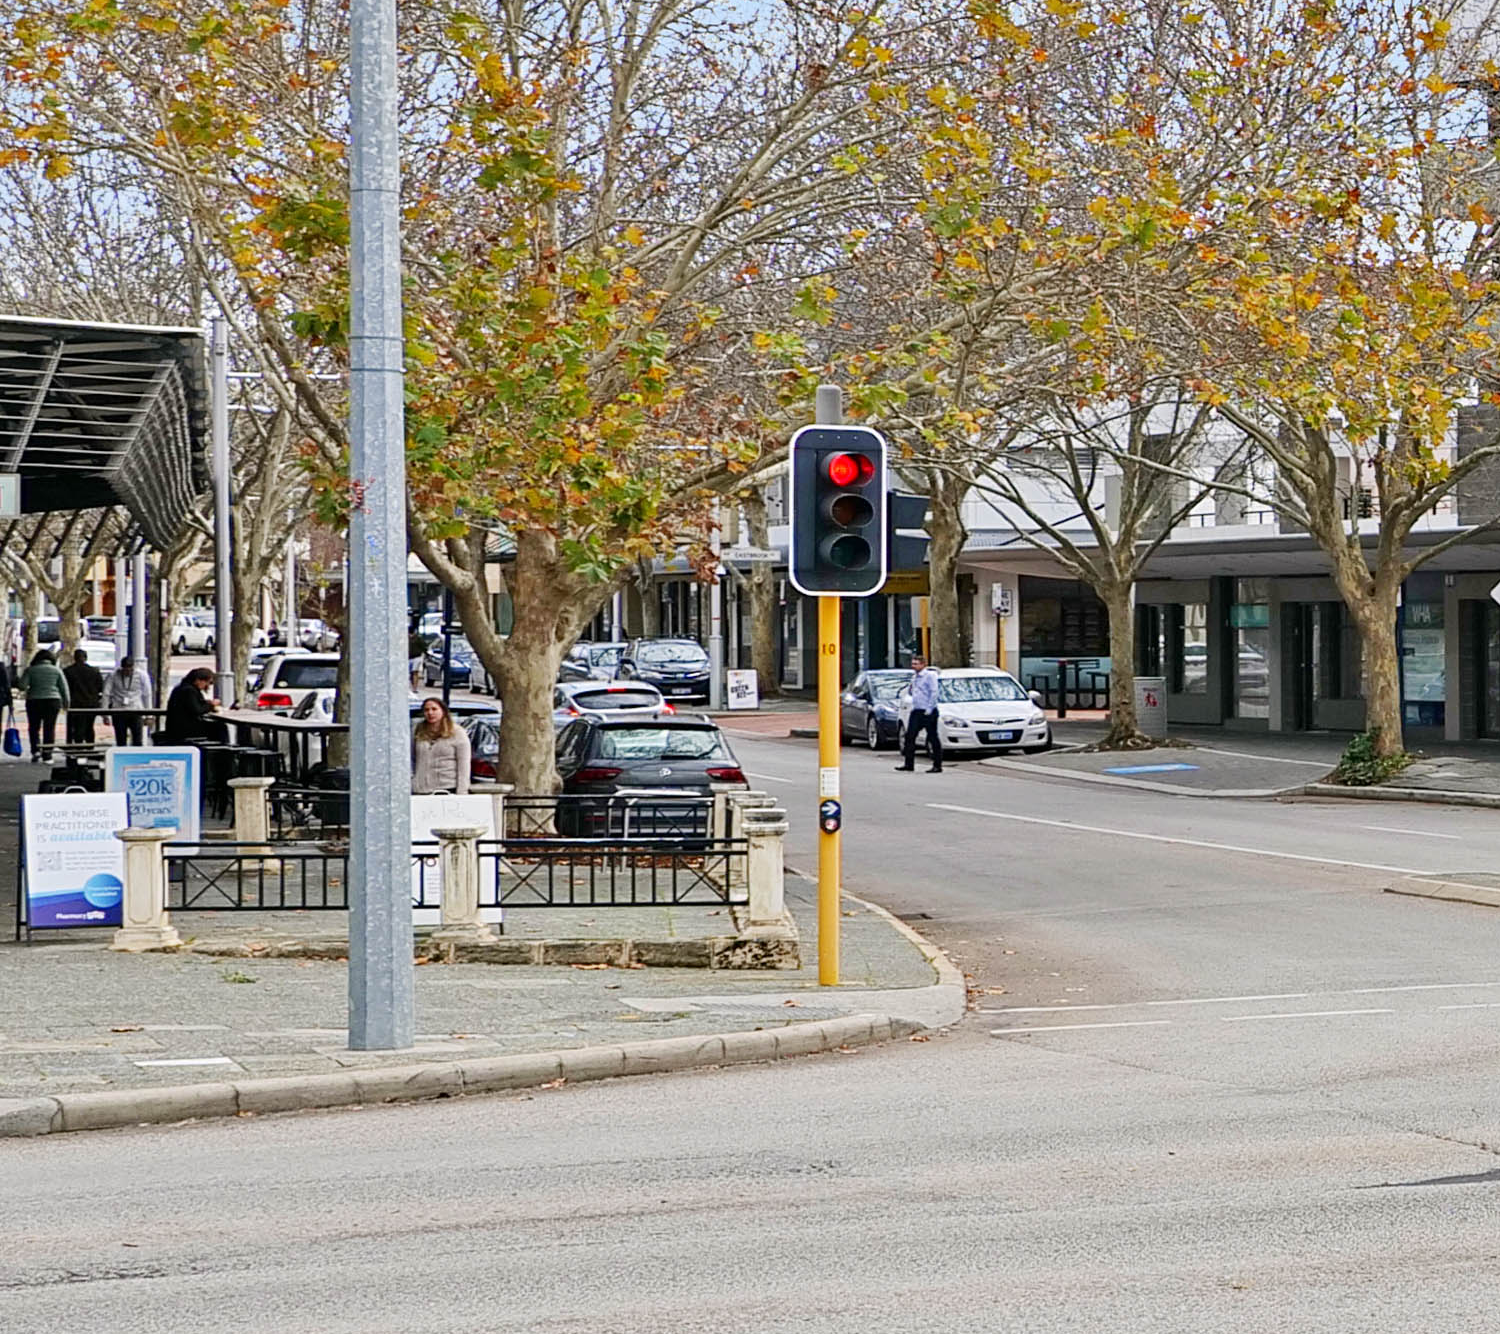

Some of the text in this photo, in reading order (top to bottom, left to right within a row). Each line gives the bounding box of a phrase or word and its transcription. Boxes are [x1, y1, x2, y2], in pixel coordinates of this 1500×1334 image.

[129, 778, 172, 796] $20k
[43, 809, 111, 819] OUR NURSE
[35, 820, 119, 831] PRACTITIONER
[37, 834, 47, 844] IS
